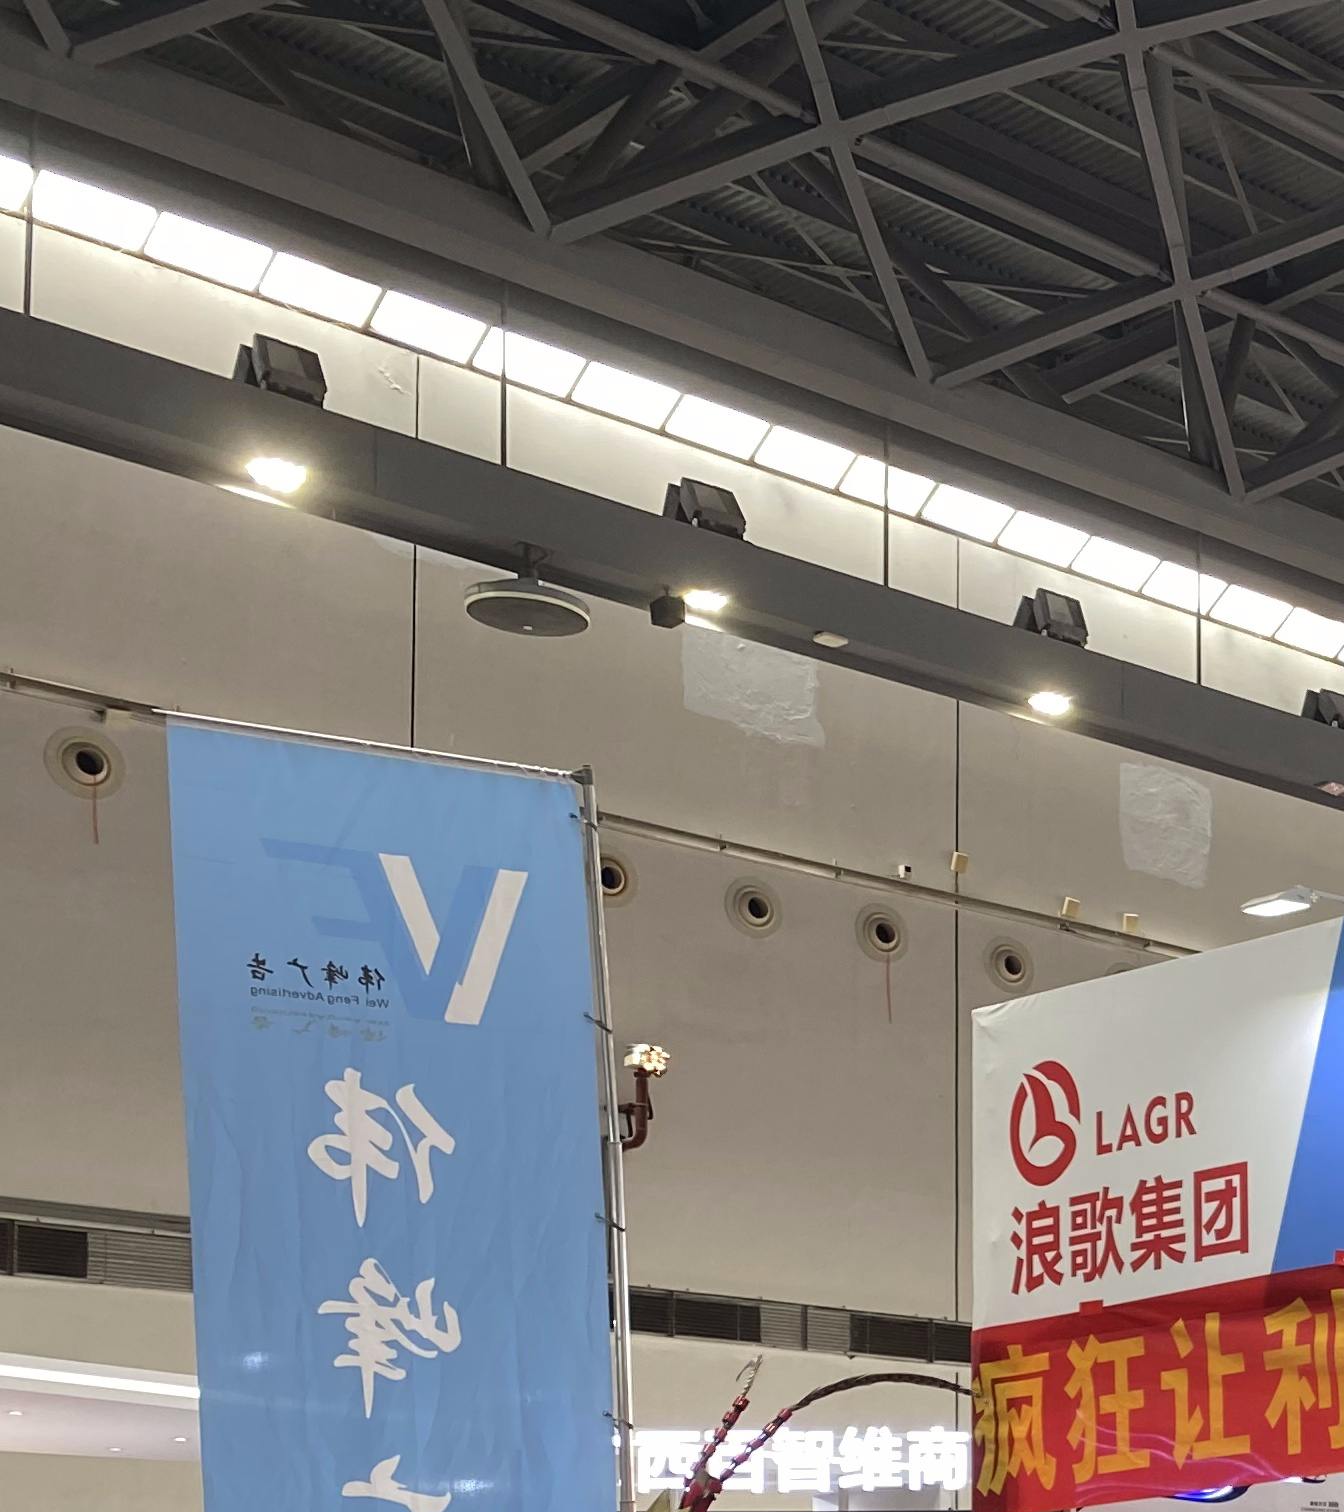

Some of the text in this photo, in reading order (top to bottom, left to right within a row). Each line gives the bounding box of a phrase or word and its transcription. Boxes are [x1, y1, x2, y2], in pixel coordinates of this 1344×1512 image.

[1095, 1091, 1198, 1156] LAGR
[1010, 1161, 1249, 1296] 浪歌集团
